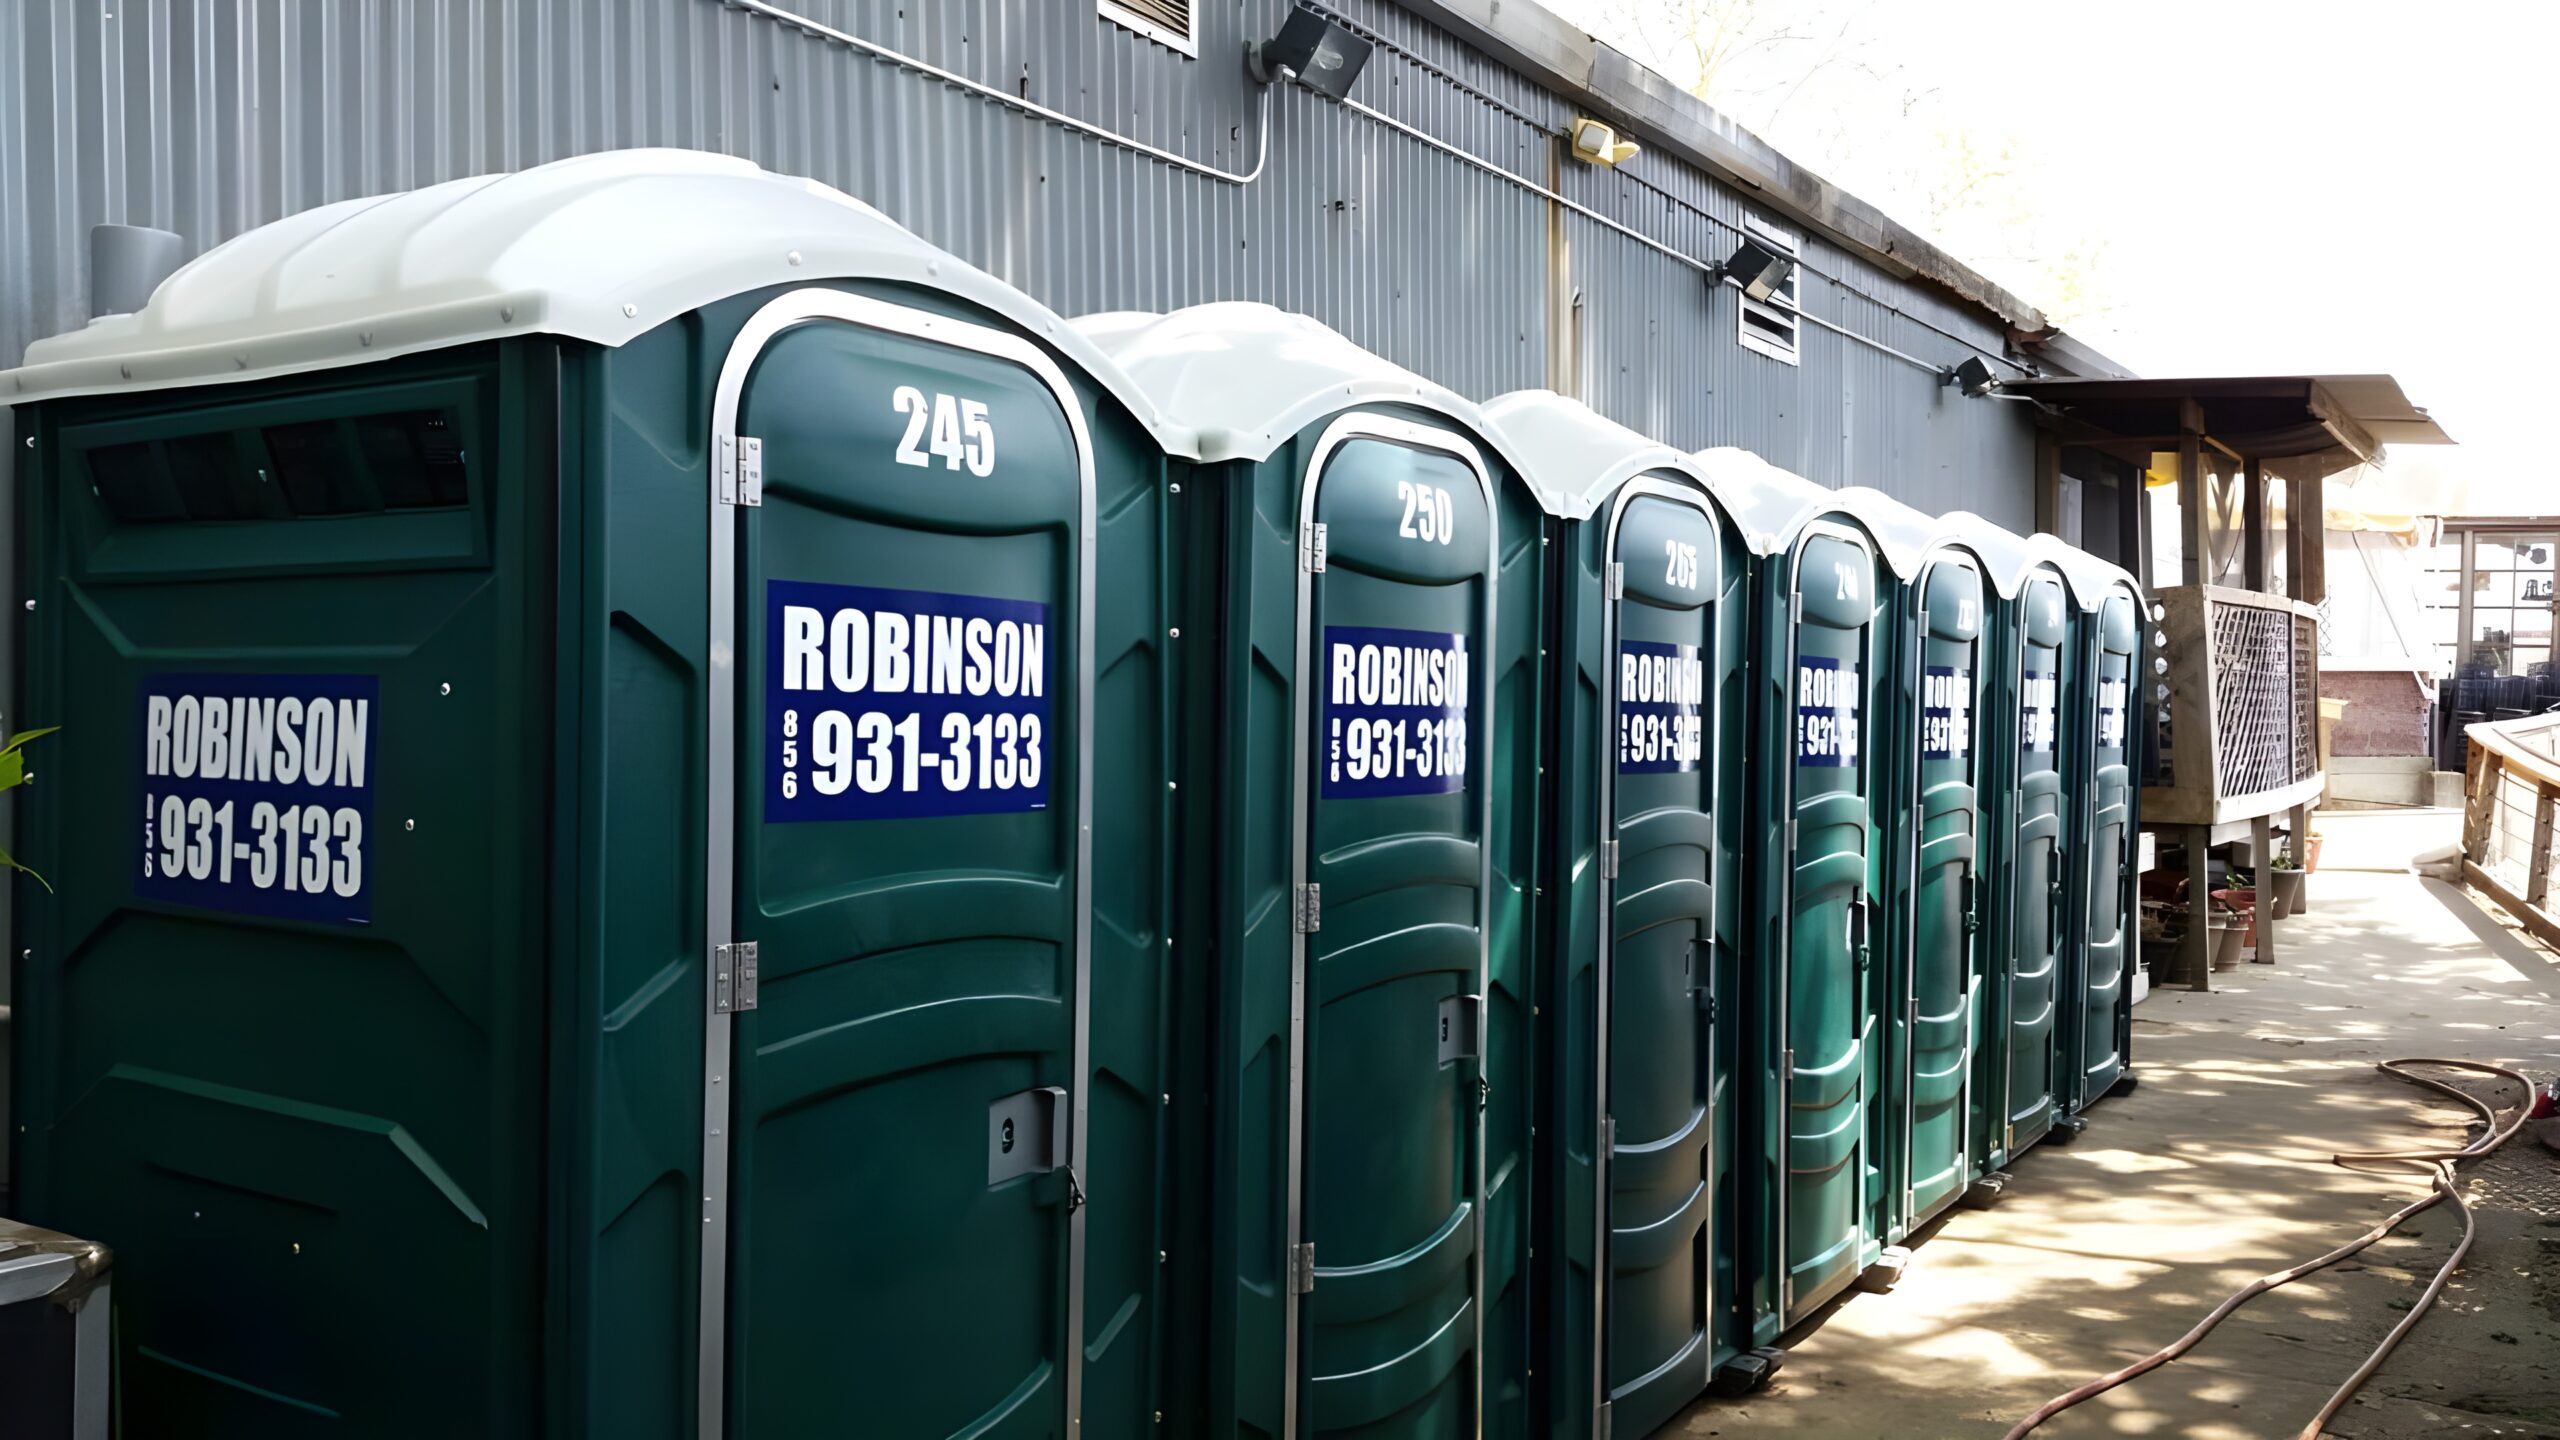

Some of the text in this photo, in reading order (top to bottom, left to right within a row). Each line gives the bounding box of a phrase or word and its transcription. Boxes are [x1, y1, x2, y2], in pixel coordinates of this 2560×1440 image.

[893, 385, 995, 477] 245
[1398, 480, 1453, 545] 250
[783, 605, 1044, 697] ROBINSON
[1332, 643, 1468, 707] ROBINSON
[147, 694, 368, 787] ROBINSON
[782, 709, 798, 799] 856
[812, 709, 1042, 796] 931-3133
[1346, 717, 1467, 781] 931-3133
[1631, 714, 1702, 762] 931-3
[160, 795, 363, 898] 931-3133
